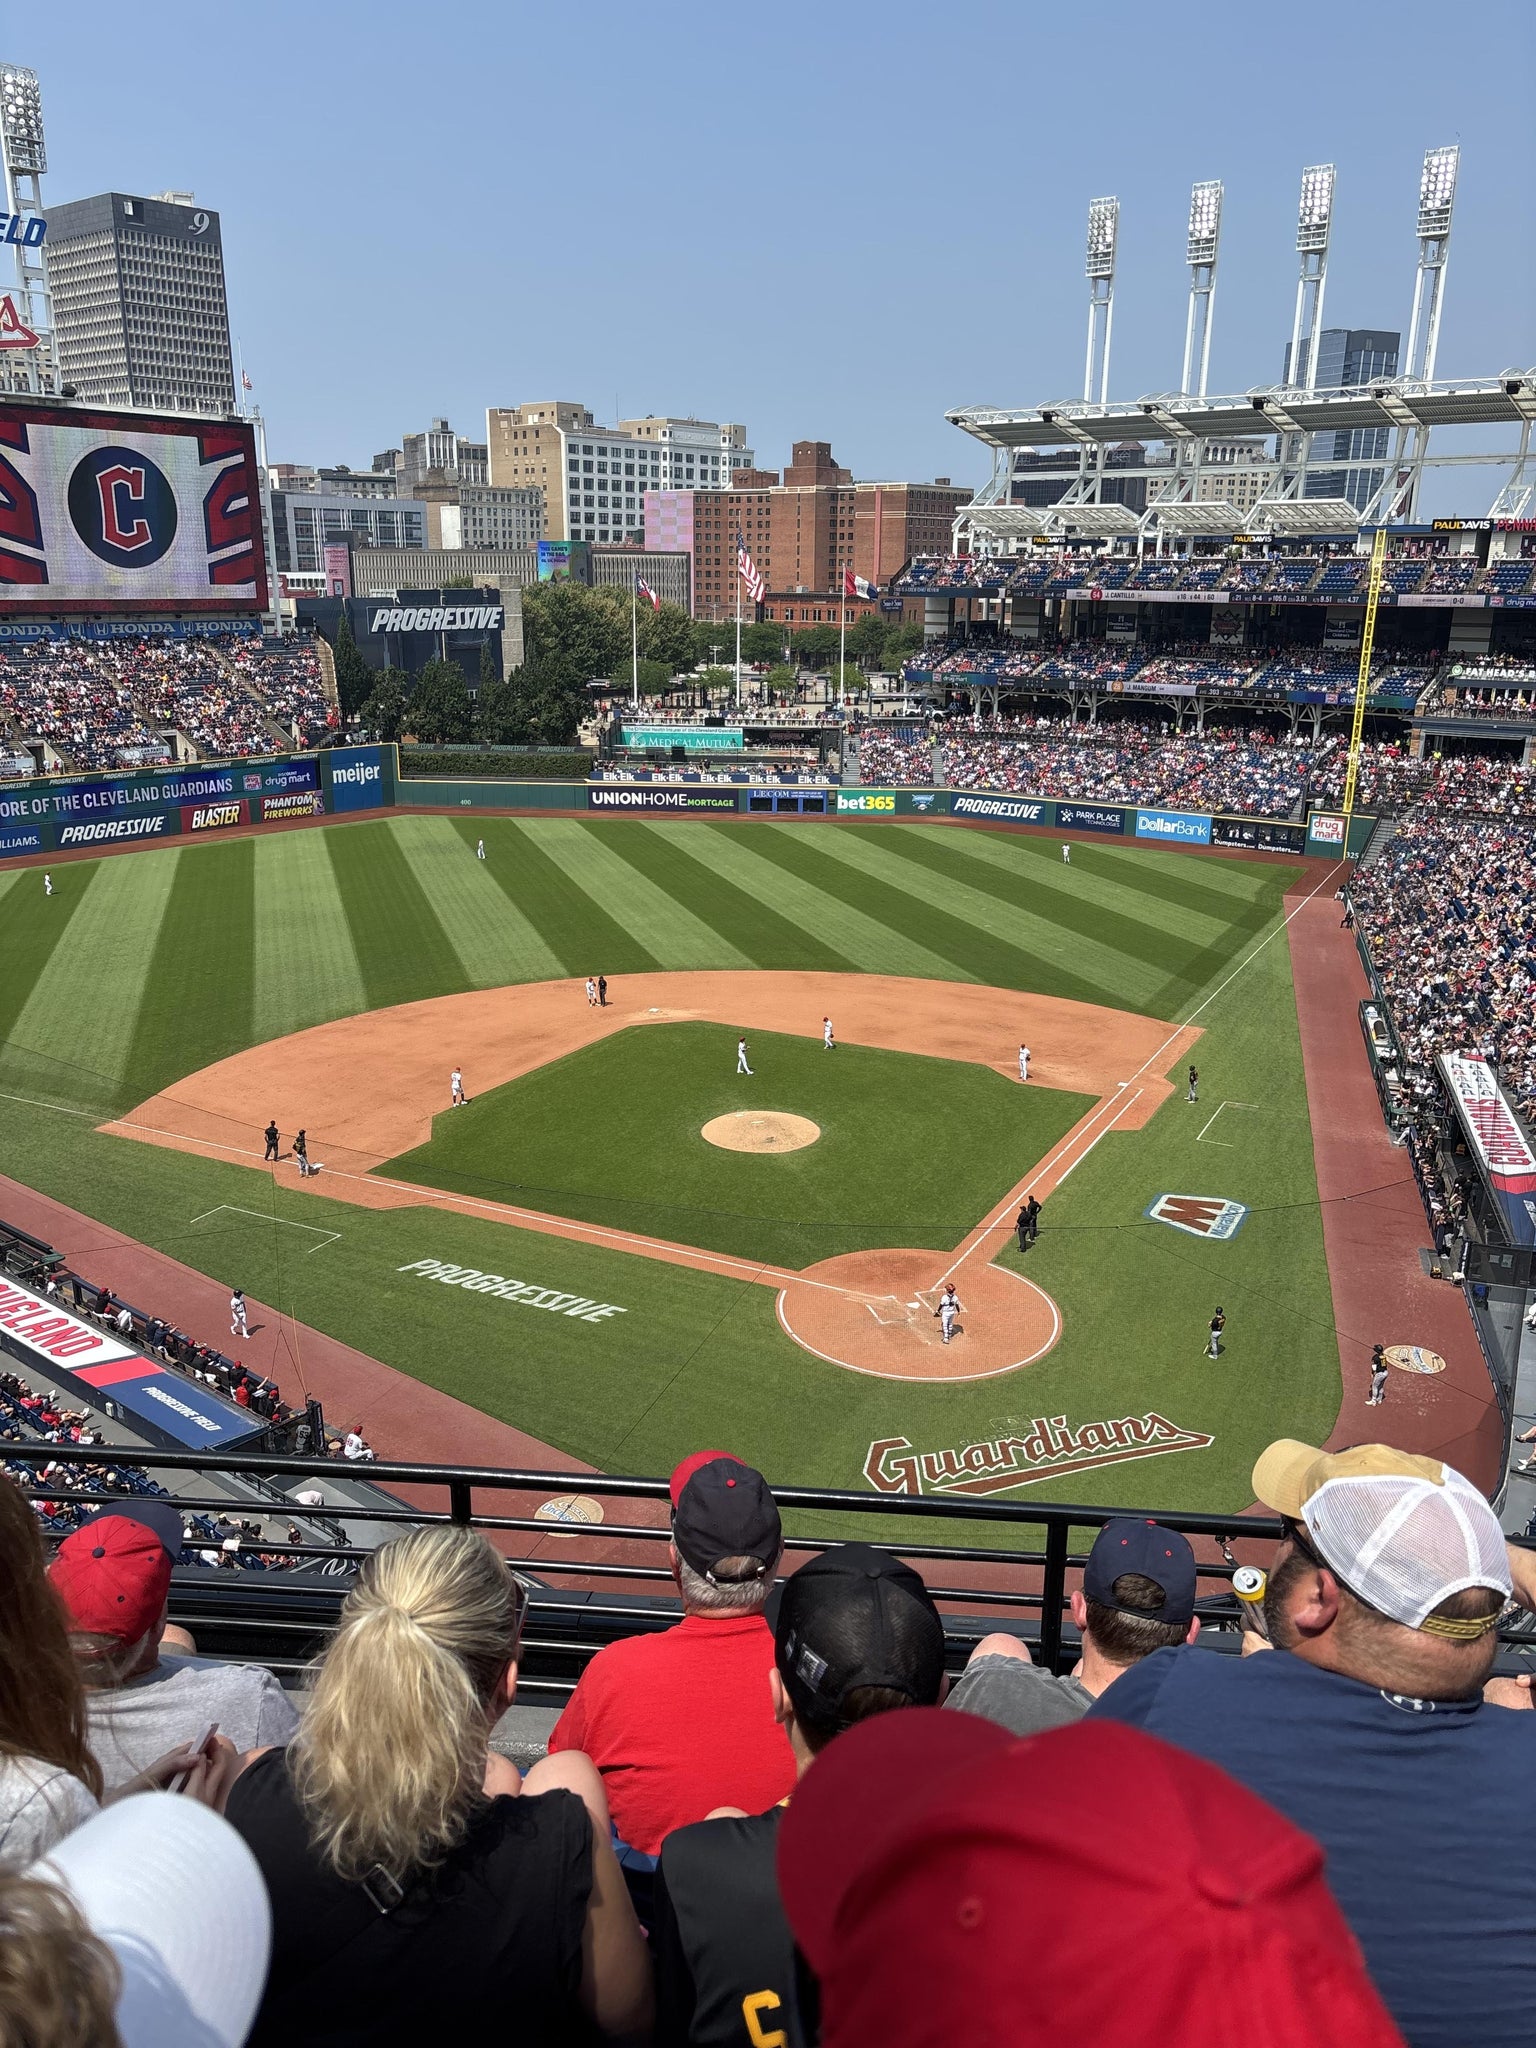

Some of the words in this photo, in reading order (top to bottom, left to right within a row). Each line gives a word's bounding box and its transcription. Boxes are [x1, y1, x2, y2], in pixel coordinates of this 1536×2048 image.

[192, 213, 210, 236] 9
[96, 464, 152, 552] C
[110, 623, 176, 634] HONDA
[194, 620, 254, 632] HONDA
[371, 606, 503, 633] PROGRESSIVE
[265, 776, 288, 788] drug
[288, 772, 311, 784] mart
[332, 762, 380, 786] meijer
[32, 798, 50, 814] OF
[52, 795, 81, 812] THE
[83, 786, 159, 808] CLEVELAND
[162, 778, 233, 800] GUARDIANS
[264, 794, 313, 810] PHANTOM
[837, 794, 895, 810] bet365
[192, 805, 241, 829] BLASTER
[264, 805, 313, 820] FIREWORKS
[954, 798, 1042, 819] PROGRESSIVE
[1076, 810, 1096, 822] PARK
[1096, 812, 1121, 823] PLACE
[60, 816, 164, 844] PROGRESSIVE
[1314, 818, 1338, 832] drug
[1315, 828, 1343, 840] mart
[1346, 851, 1360, 859] 325
[1464, 1098, 1532, 1166] GUARDIANS
[1210, 1204, 1243, 1238] Marathon
[396, 1258, 629, 1324] PROGRESSIVE
[141, 1386, 198, 1419] PROGRESSIVE
[192, 1414, 224, 1432] FIELD
[862, 1412, 1215, 1496] Guardians
